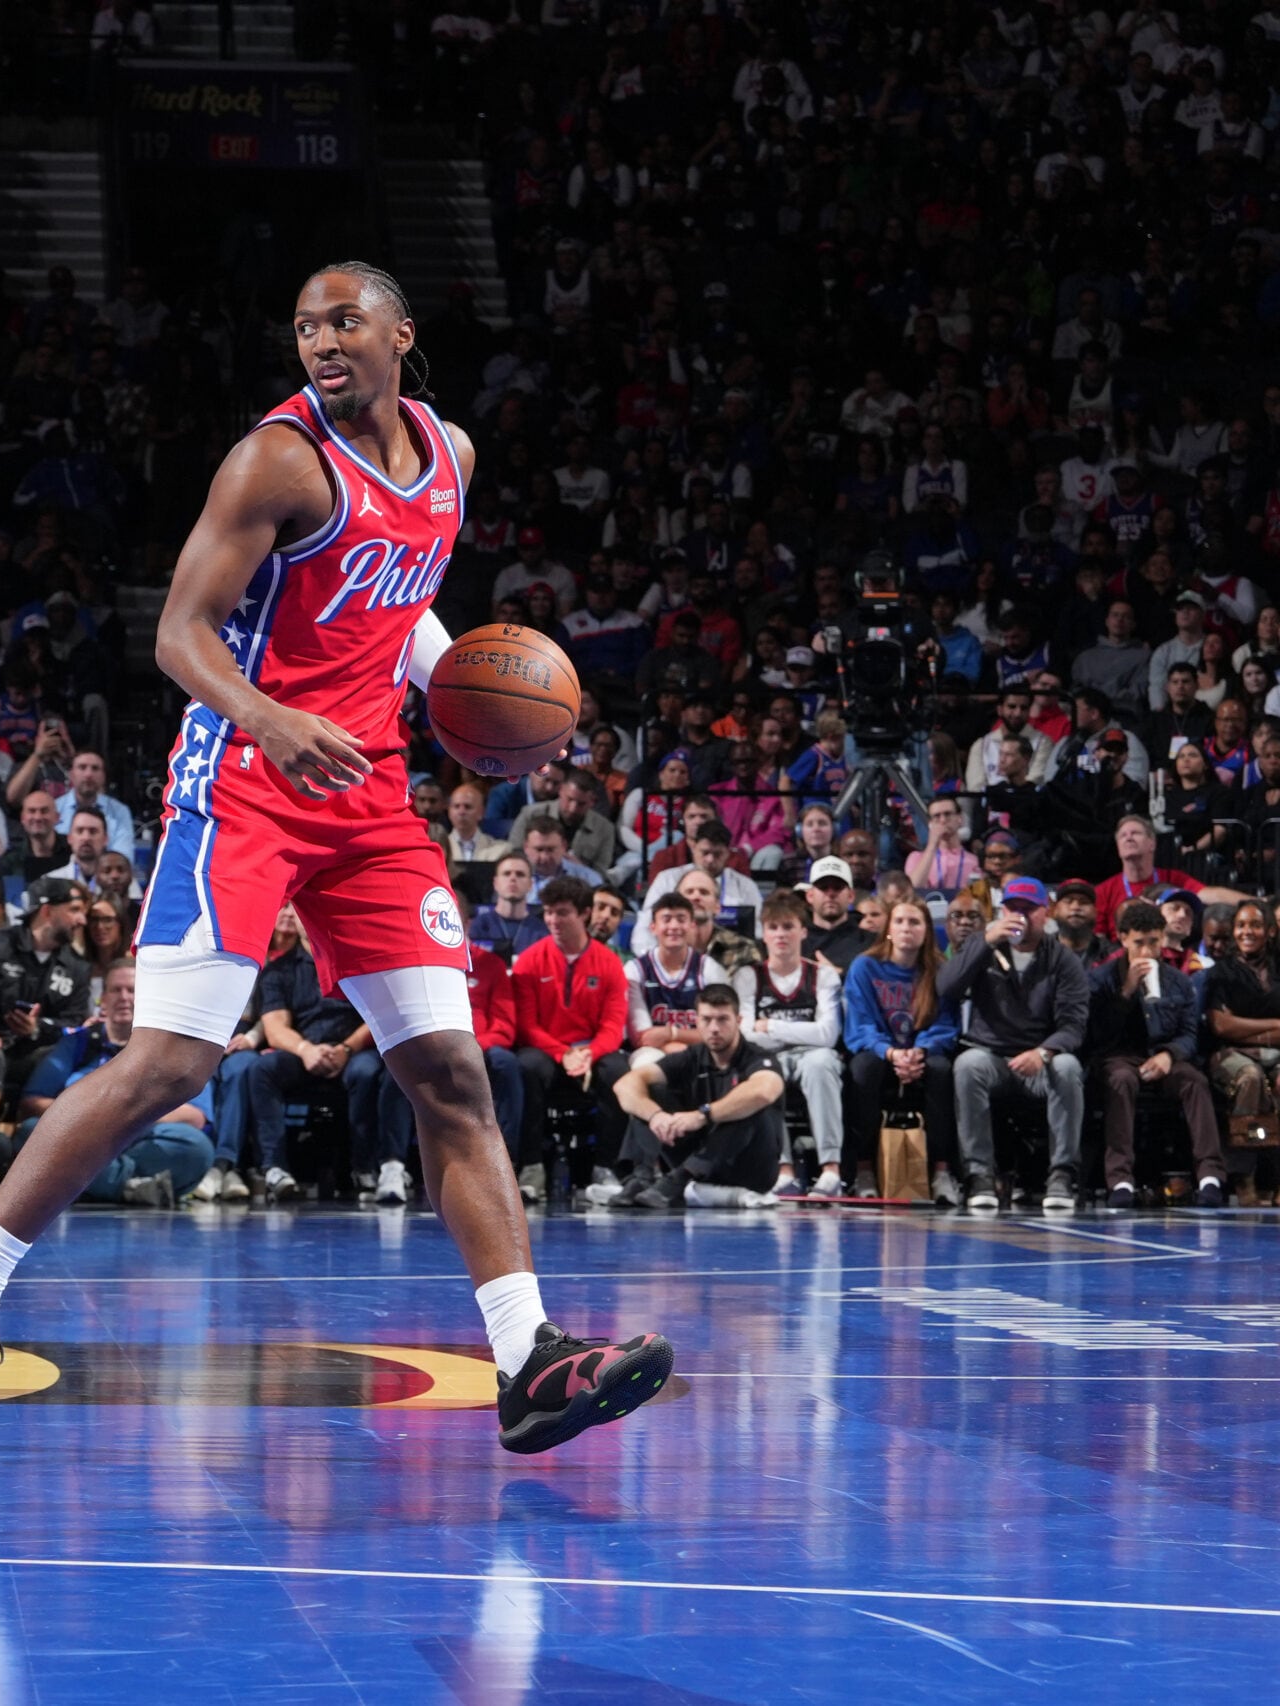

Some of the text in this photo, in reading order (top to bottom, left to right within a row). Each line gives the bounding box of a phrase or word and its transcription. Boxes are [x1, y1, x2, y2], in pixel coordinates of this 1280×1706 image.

[200, 84, 264, 117] Rock
[130, 130, 170, 160] 119
[219, 136, 253, 160] EXIT
[296, 135, 338, 164] 118
[430, 488, 455, 502] Bloom
[1078, 475, 1095, 499] 3
[430, 502, 455, 514] energy
[454, 651, 551, 691] Wilson
